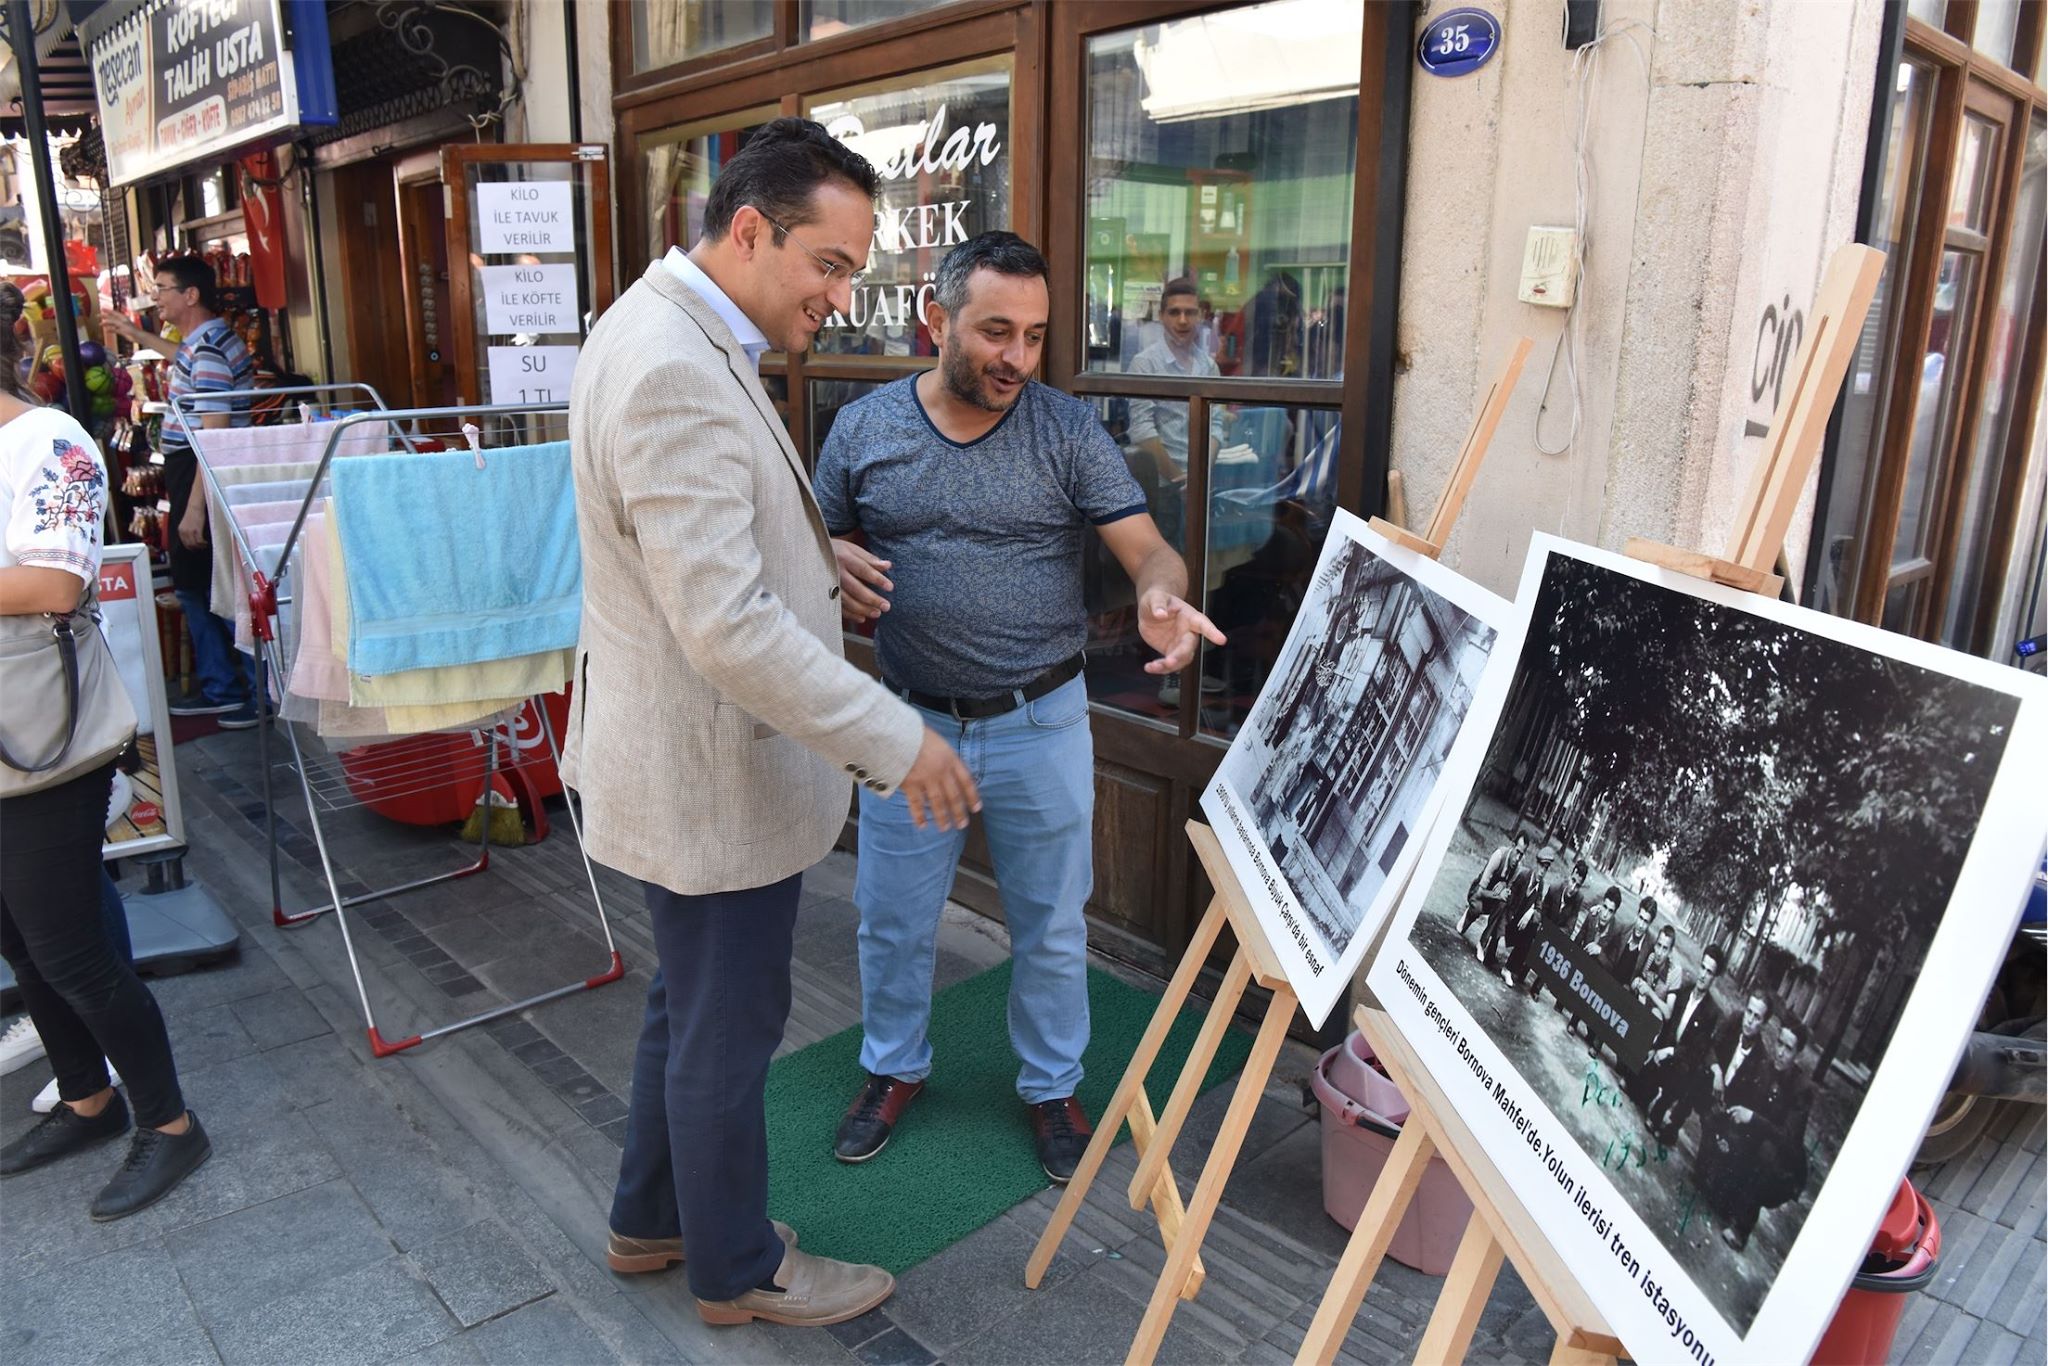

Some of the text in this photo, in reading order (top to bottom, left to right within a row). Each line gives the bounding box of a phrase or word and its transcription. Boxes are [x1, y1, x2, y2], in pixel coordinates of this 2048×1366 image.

[1440, 24, 1470, 55] 35
[164, 21, 264, 104] TALİH USTA
[511, 187, 539, 201] KİLO
[494, 209, 559, 224] İLE TAVUK
[503, 231, 552, 246] VERİLİR
[515, 269, 544, 283] KİLO
[501, 291, 562, 305] İLE KÖFTE
[509, 312, 557, 327] VERİLİR
[521, 355, 547, 373] SU
[1253, 851, 1270, 886] Bornova
[1267, 878, 1283, 909] Büyük
[1297, 931, 1309, 953] bir
[1305, 947, 1325, 978] esnaf
[1540, 940, 1629, 1038] 1936 Bornova
[1395, 959, 1429, 1005] Dönemin
[1424, 1000, 1461, 1046] gençleri
[1456, 1037, 1494, 1091] Bornova
[1573, 1185, 1614, 1241] ilerisi
[1610, 1233, 1641, 1279] tren
